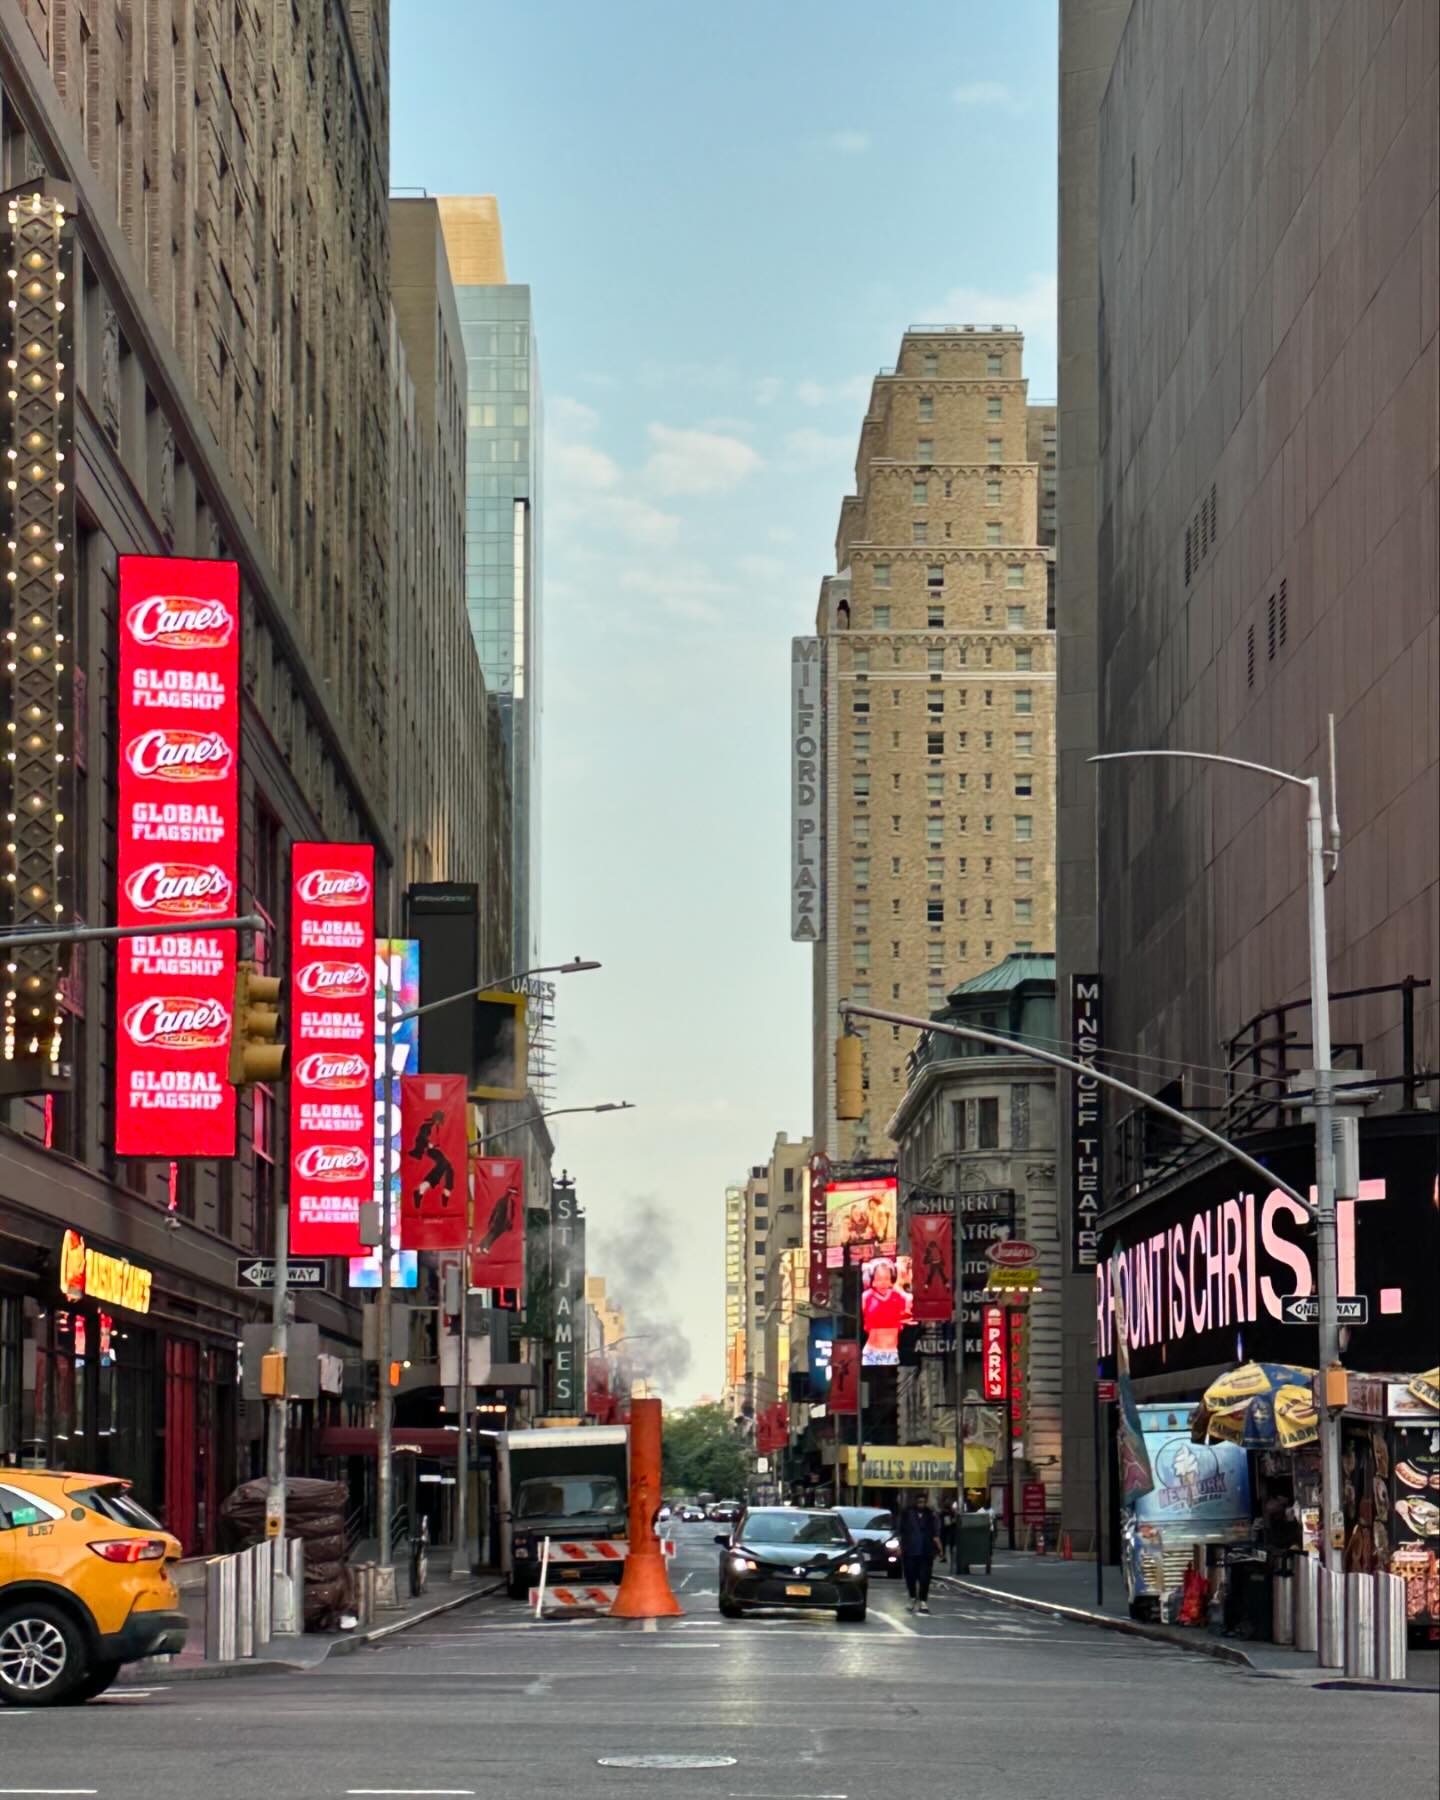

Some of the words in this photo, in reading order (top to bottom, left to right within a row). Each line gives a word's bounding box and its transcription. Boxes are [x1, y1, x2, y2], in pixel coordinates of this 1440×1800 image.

[133, 669, 225, 691] GLOBAL
[133, 690, 225, 709] FLAGSHIP
[793, 640, 818, 806] MILFORD
[133, 803, 224, 824] GLOBAL
[132, 823, 224, 842] FLAGSHIP
[794, 818, 817, 938] PLAZA
[302, 921, 363, 935] GLOBAL
[132, 937, 223, 957] GLOBAL
[301, 935, 364, 947] FLAGSHIP
[131, 957, 223, 975] FLAGSHIP
[301, 1013, 363, 1026] GLOBAL
[300, 1026, 363, 1039] FLAGSHIP
[1077, 983, 1099, 1127] MINSKOFF
[131, 1071, 221, 1091] GLOBAL
[130, 1091, 223, 1109] FLAGSHIP
[301, 1104, 363, 1118] GLOBAL
[300, 1118, 364, 1131] FLAGSHIP
[1078, 1138, 1099, 1266] THEATRE
[289, 1268, 314, 1280] WAY
[1295, 1303, 1318, 1315] ONE
[555, 1270, 573, 1399] JAMES
[988, 1328, 1002, 1381] PARK
[909, 1460, 957, 1482] KITCHE
